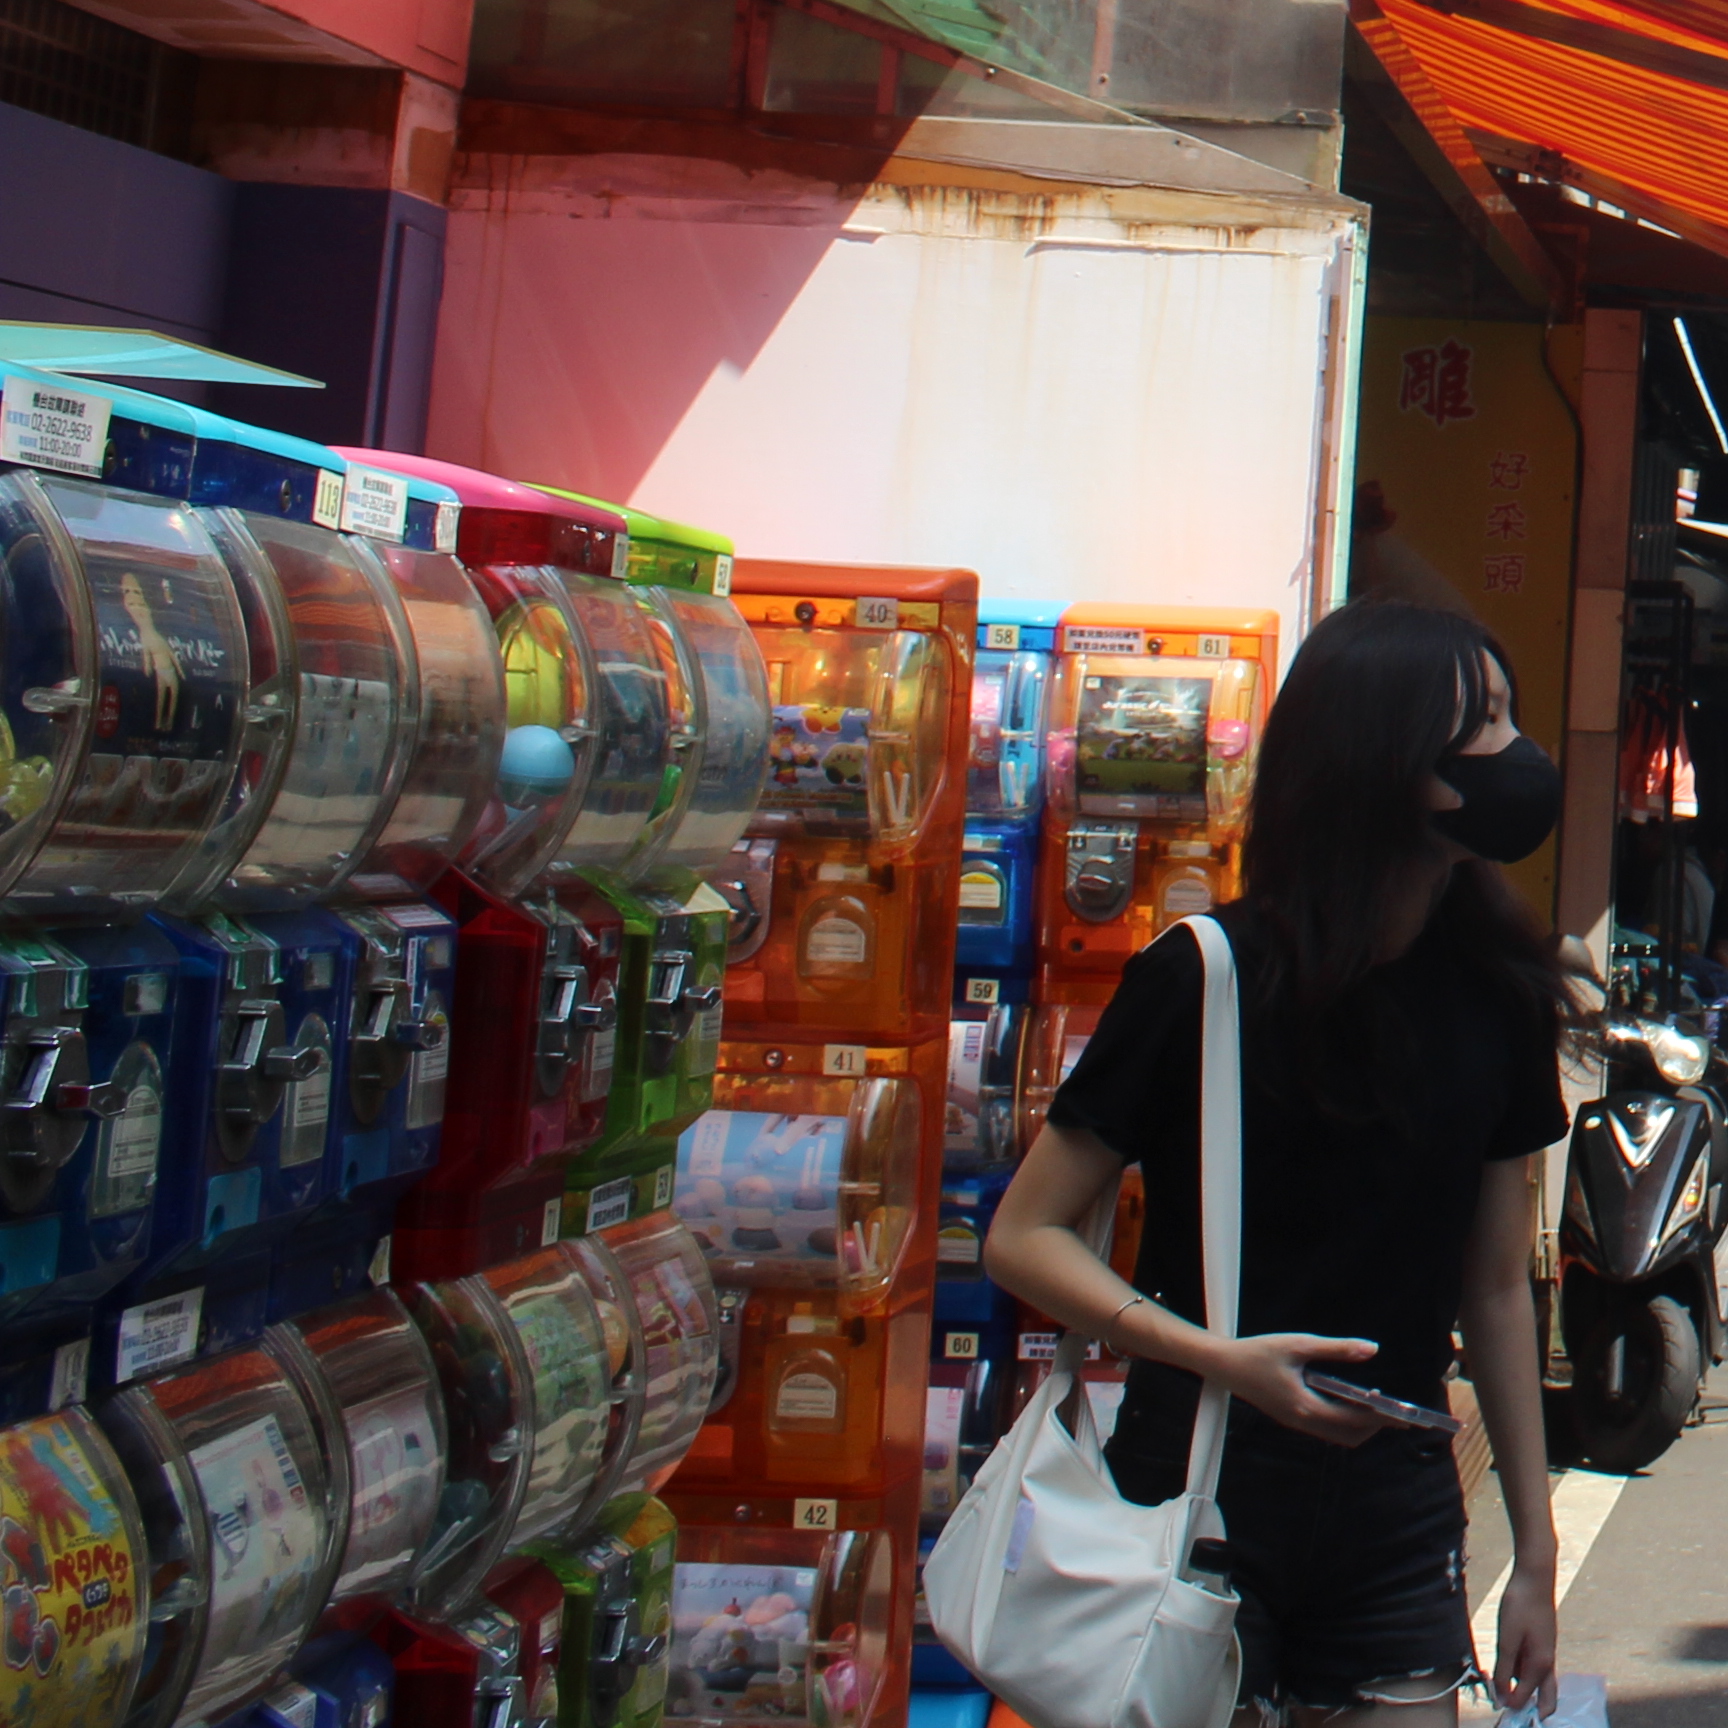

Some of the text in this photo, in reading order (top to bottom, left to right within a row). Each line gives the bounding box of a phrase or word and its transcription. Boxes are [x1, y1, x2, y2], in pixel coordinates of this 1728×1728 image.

[317, 479, 340, 518] 113
[1483, 450, 1530, 596] 好采頭
[865, 601, 887, 624] 40
[994, 628, 1014, 646] 58
[1204, 639, 1221, 655] 61
[972, 981, 994, 1001] 59
[833, 1050, 856, 1072] 41
[951, 1335, 973, 1355] 60
[804, 1504, 828, 1526] 42
